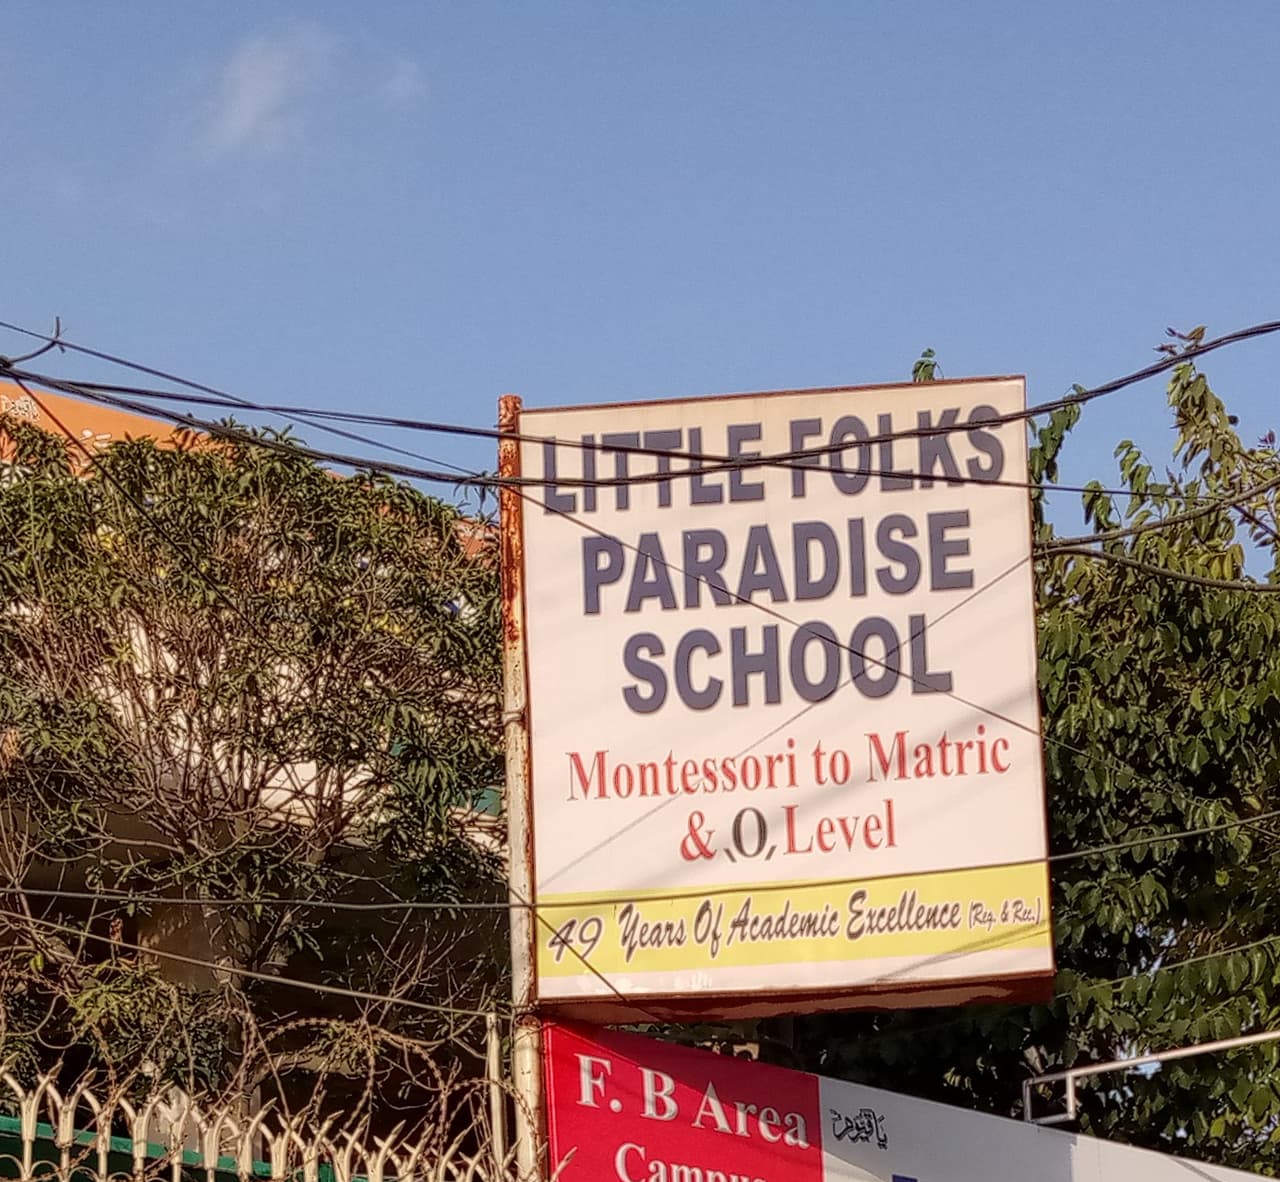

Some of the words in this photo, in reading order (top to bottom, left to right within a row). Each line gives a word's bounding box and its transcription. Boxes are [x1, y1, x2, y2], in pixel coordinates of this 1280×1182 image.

[542, 422, 764, 515] LITTLE
[789, 404, 1005, 499] FOLKS
[582, 509, 974, 615] PARADISE
[622, 612, 953, 713] SCHOOL
[567, 738, 799, 800] Montessori
[812, 741, 851, 788] to
[864, 724, 1012, 783] Matric
[680, 809, 717, 862] &
[783, 799, 896, 855] Level
[548, 917, 604, 962] 49
[618, 903, 688, 962] Years
[693, 899, 723, 958] Of
[726, 896, 840, 946] Academic
[846, 889, 963, 941] Excellence
[574, 1052, 623, 1114] F.
[638, 1066, 678, 1121] B
[692, 1081, 810, 1150] Area
